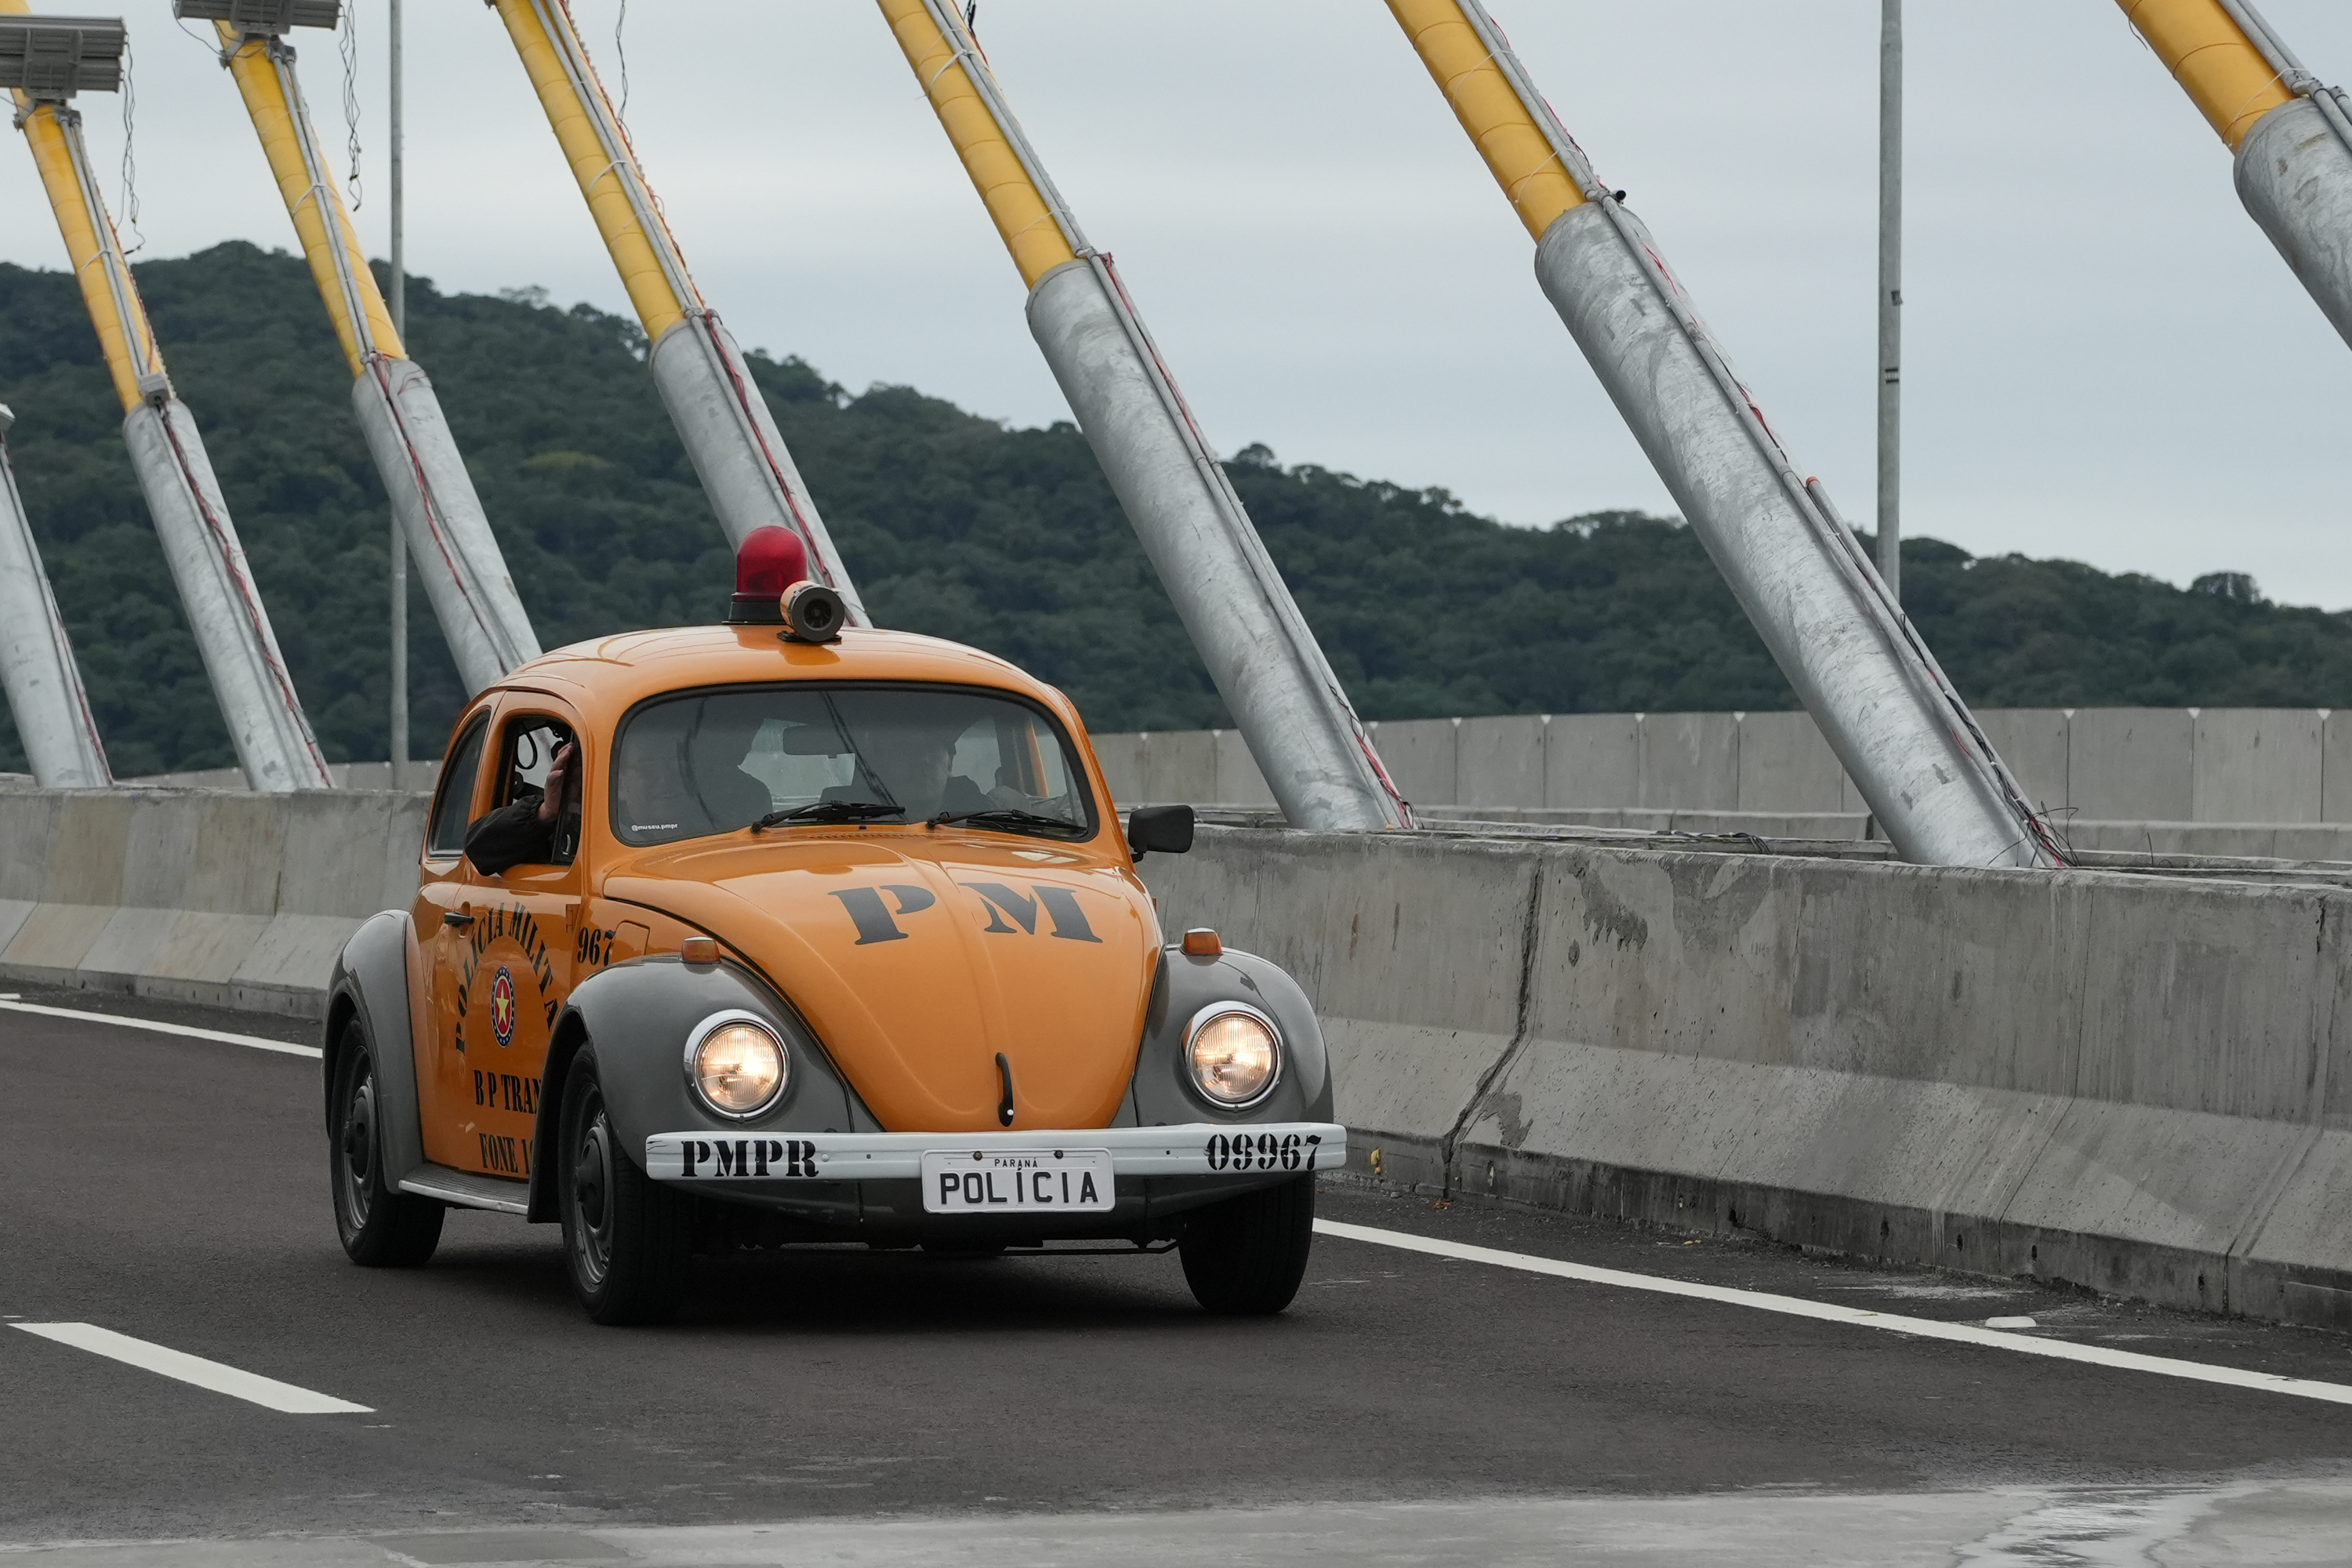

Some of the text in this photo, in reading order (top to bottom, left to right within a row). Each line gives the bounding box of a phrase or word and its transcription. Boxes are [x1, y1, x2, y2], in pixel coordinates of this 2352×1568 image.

[631, 823, 678, 832] @museu.pmpr
[827, 882, 1103, 946] PM
[577, 927, 615, 967] 967
[508, 901, 559, 1038] MILITA
[479, 1133, 533, 1175] FONE 1
[681, 1140, 819, 1178] PMPR
[994, 1157, 1038, 1168] PARANÁ
[1207, 1133, 1322, 1171] 09967
[939, 1168, 1098, 1205] POLÍCIA
